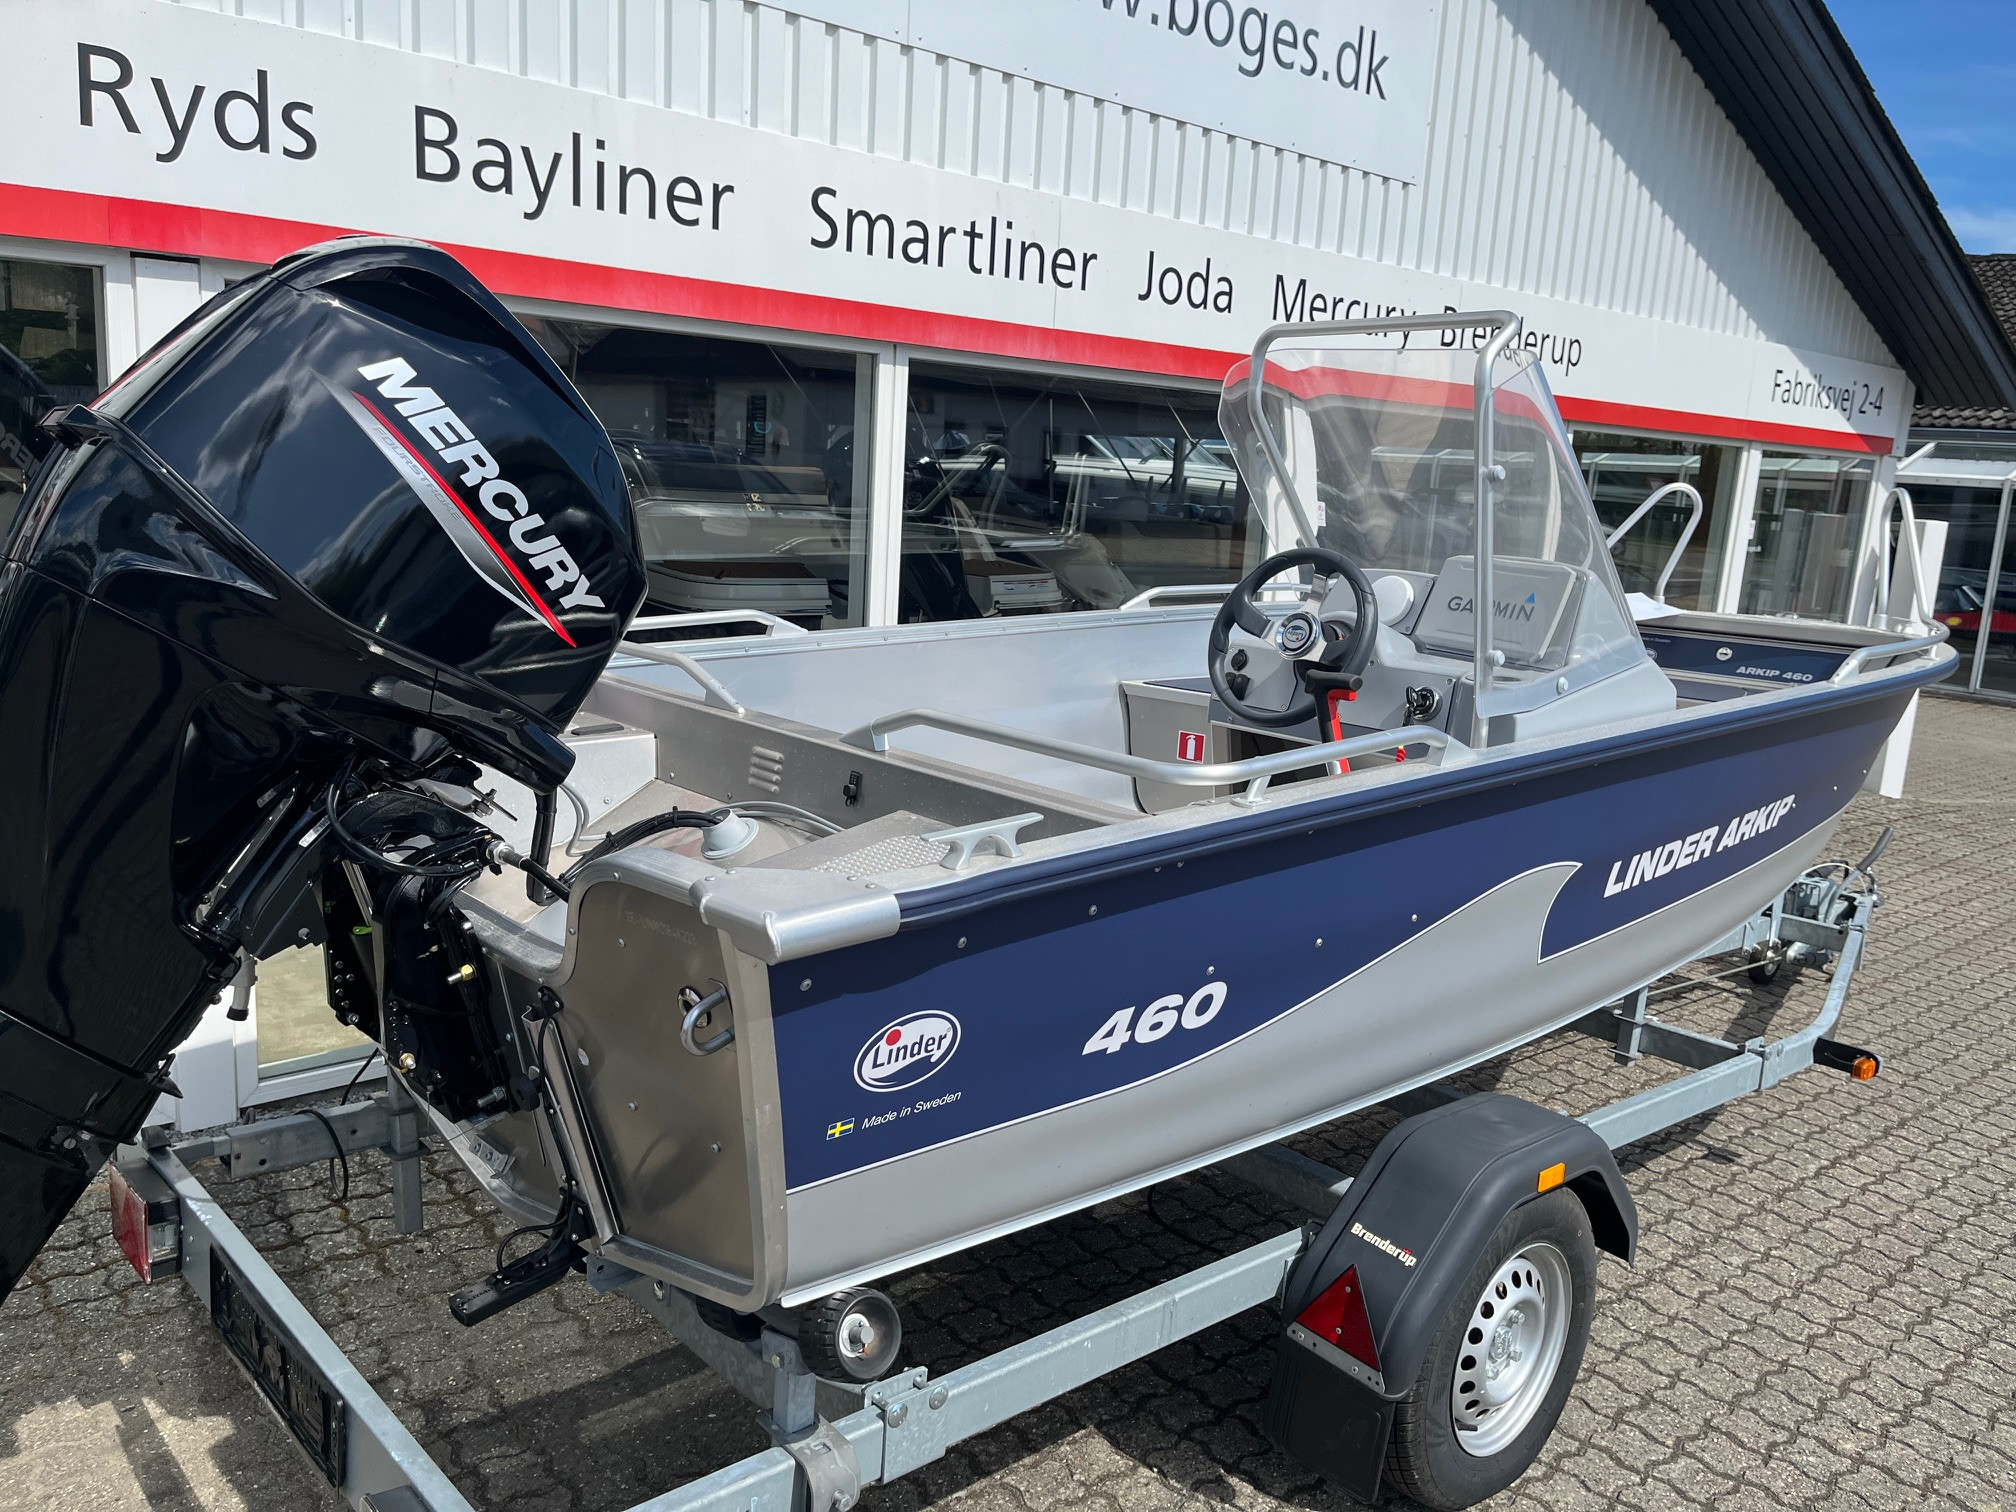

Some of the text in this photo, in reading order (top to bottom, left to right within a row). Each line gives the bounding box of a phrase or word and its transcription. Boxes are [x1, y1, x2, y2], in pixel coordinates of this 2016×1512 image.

[77, 42, 317, 163] Ryds
[414, 104, 735, 230] Bayliner
[810, 186, 1098, 291] Smartliner
[1137, 250, 1234, 314] Joda
[1272, 274, 1416, 350] Mercury
[1440, 305, 1582, 376] Brederup
[1771, 369, 1884, 421] Fabriksvej 2-4
[357, 356, 606, 610] MERCURY
[372, 425, 461, 520] FOURSTROKE
[1447, 595, 1535, 622] GAMIN
[1735, 665, 1813, 682] ARKIP 460
[1603, 794, 1796, 898] LINDER ARKIP
[871, 1033, 948, 1070] Linder
[1082, 981, 1228, 1056] 460
[861, 1091, 962, 1130] Made in Sweden
[1350, 1222, 1418, 1267] Brenderup
